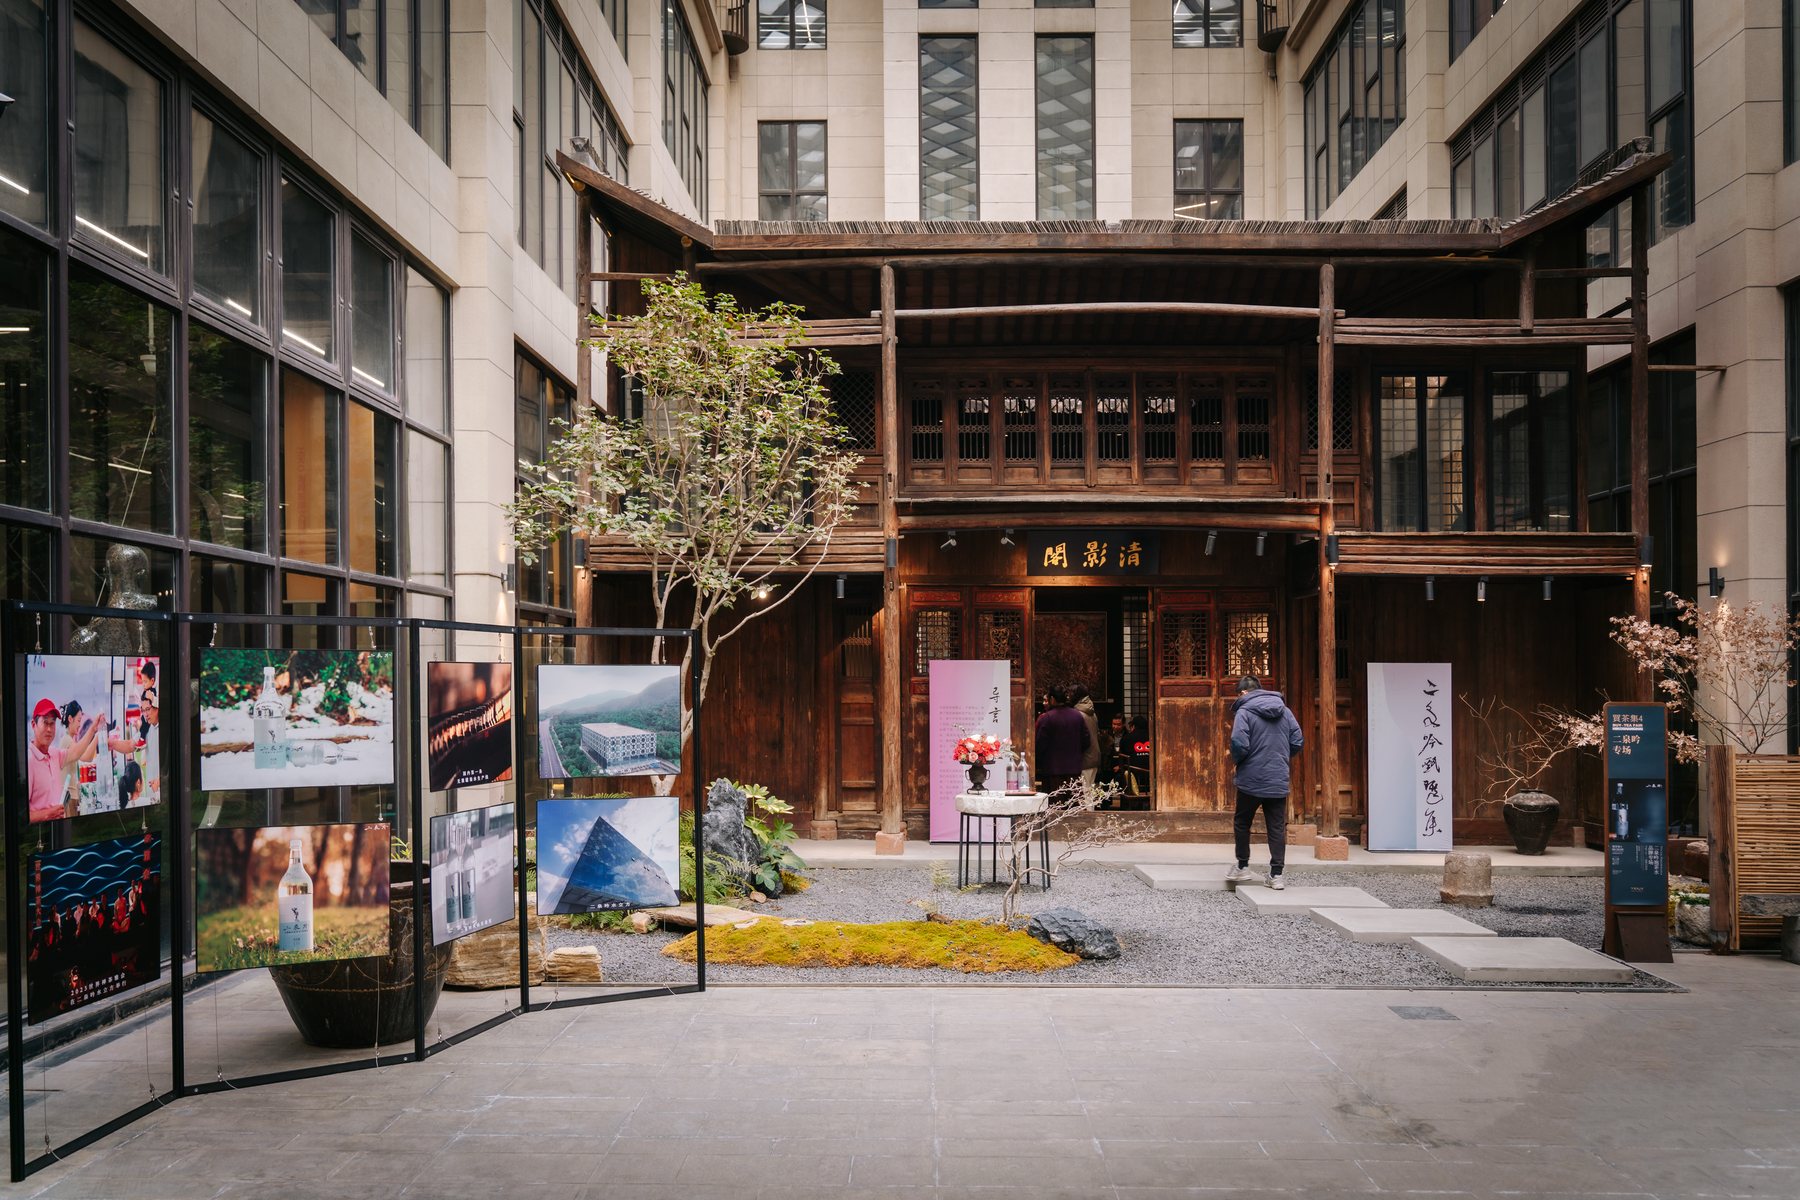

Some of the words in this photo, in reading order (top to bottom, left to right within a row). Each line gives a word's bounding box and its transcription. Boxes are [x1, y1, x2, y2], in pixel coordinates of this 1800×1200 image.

[1612, 714, 1643, 723] 買茶集4
[1613, 734, 1640, 744] 二泉吟
[1612, 745, 1632, 755] 专场
